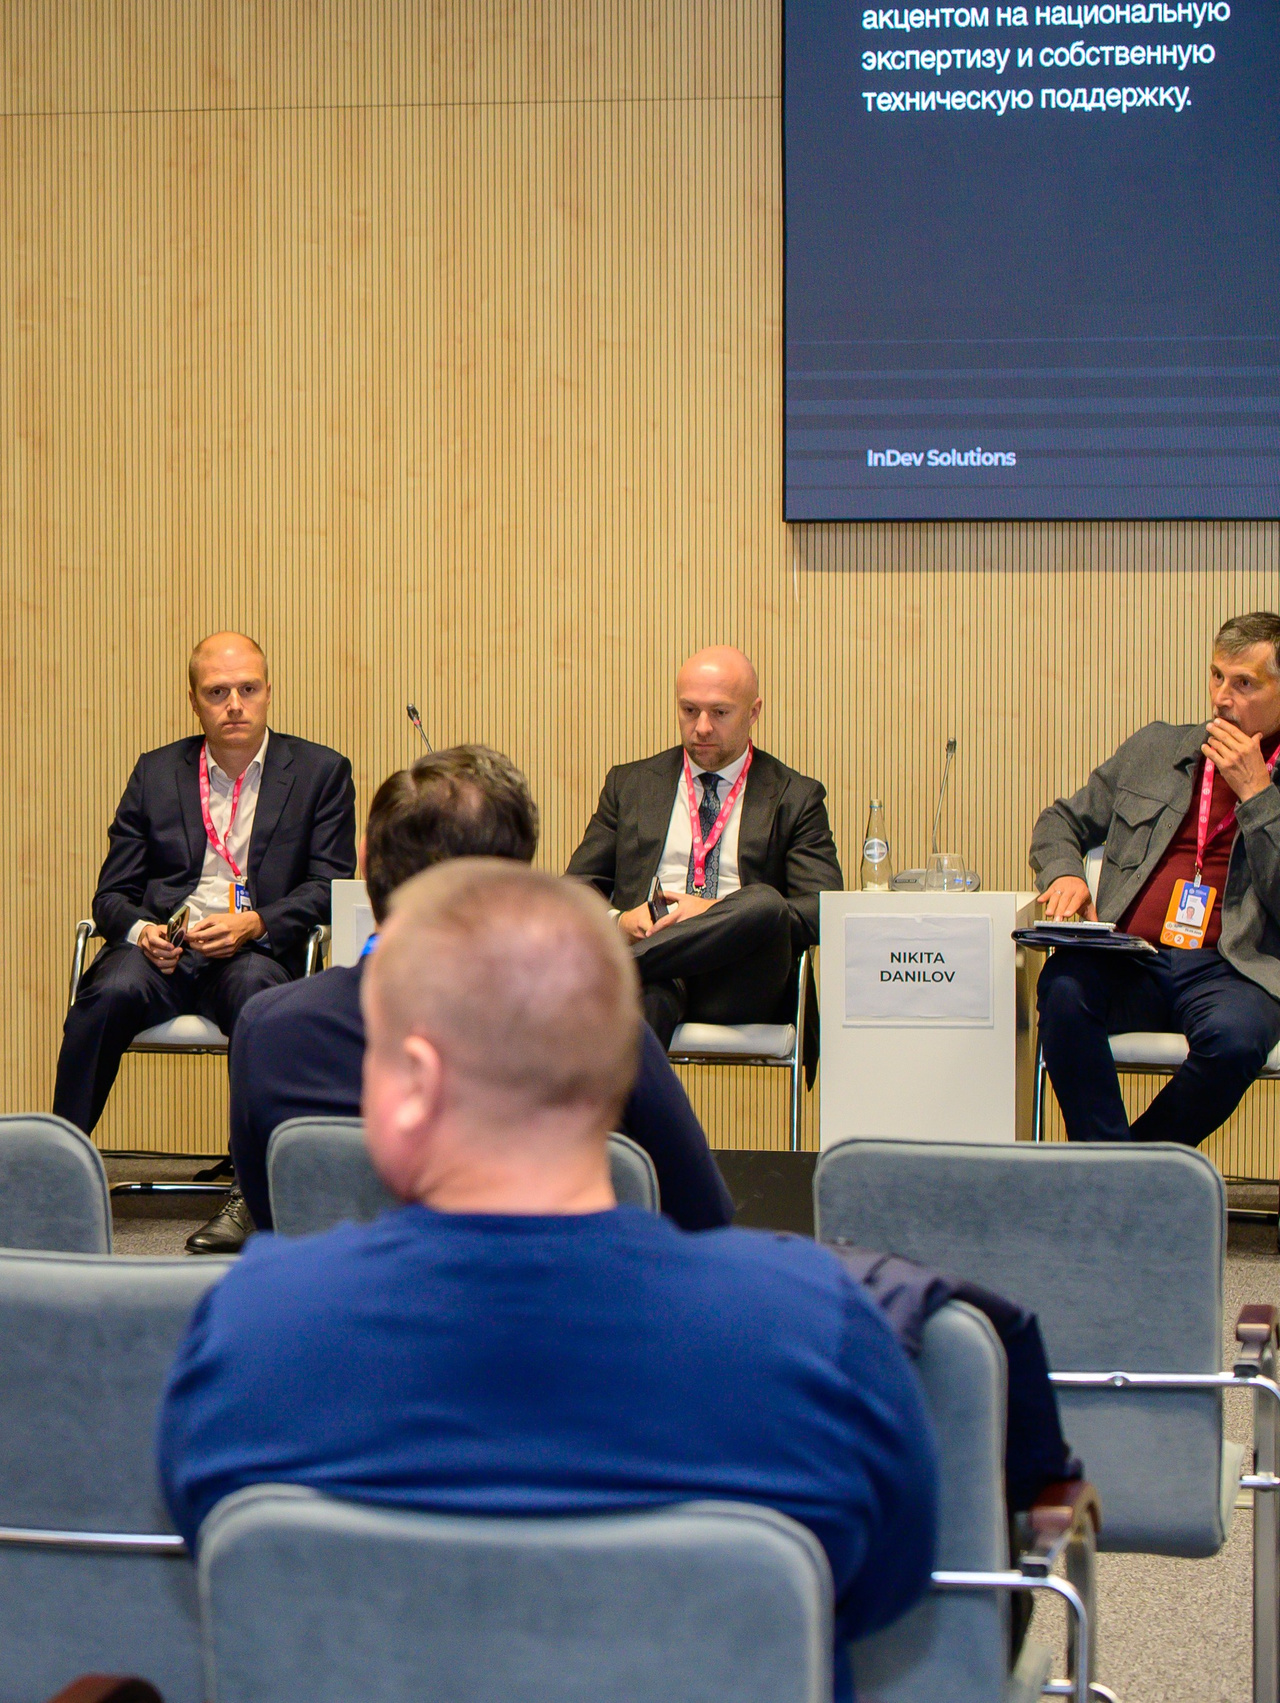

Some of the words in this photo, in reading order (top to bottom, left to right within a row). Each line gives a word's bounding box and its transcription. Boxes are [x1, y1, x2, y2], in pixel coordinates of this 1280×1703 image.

[861, 6, 989, 33] акцентом
[995, 6, 1030, 28] на
[1034, 1, 1231, 29] национальную
[860, 46, 1011, 76] экспертизу
[1016, 47, 1034, 68] и
[1038, 39, 1216, 71] собственную
[860, 87, 1034, 117] техническую
[1039, 85, 1193, 114] поддержку.
[866, 448, 924, 468] InDev
[926, 446, 1017, 467] Solutions
[889, 951, 945, 965] NIKITA
[879, 970, 956, 984] DANILOV
